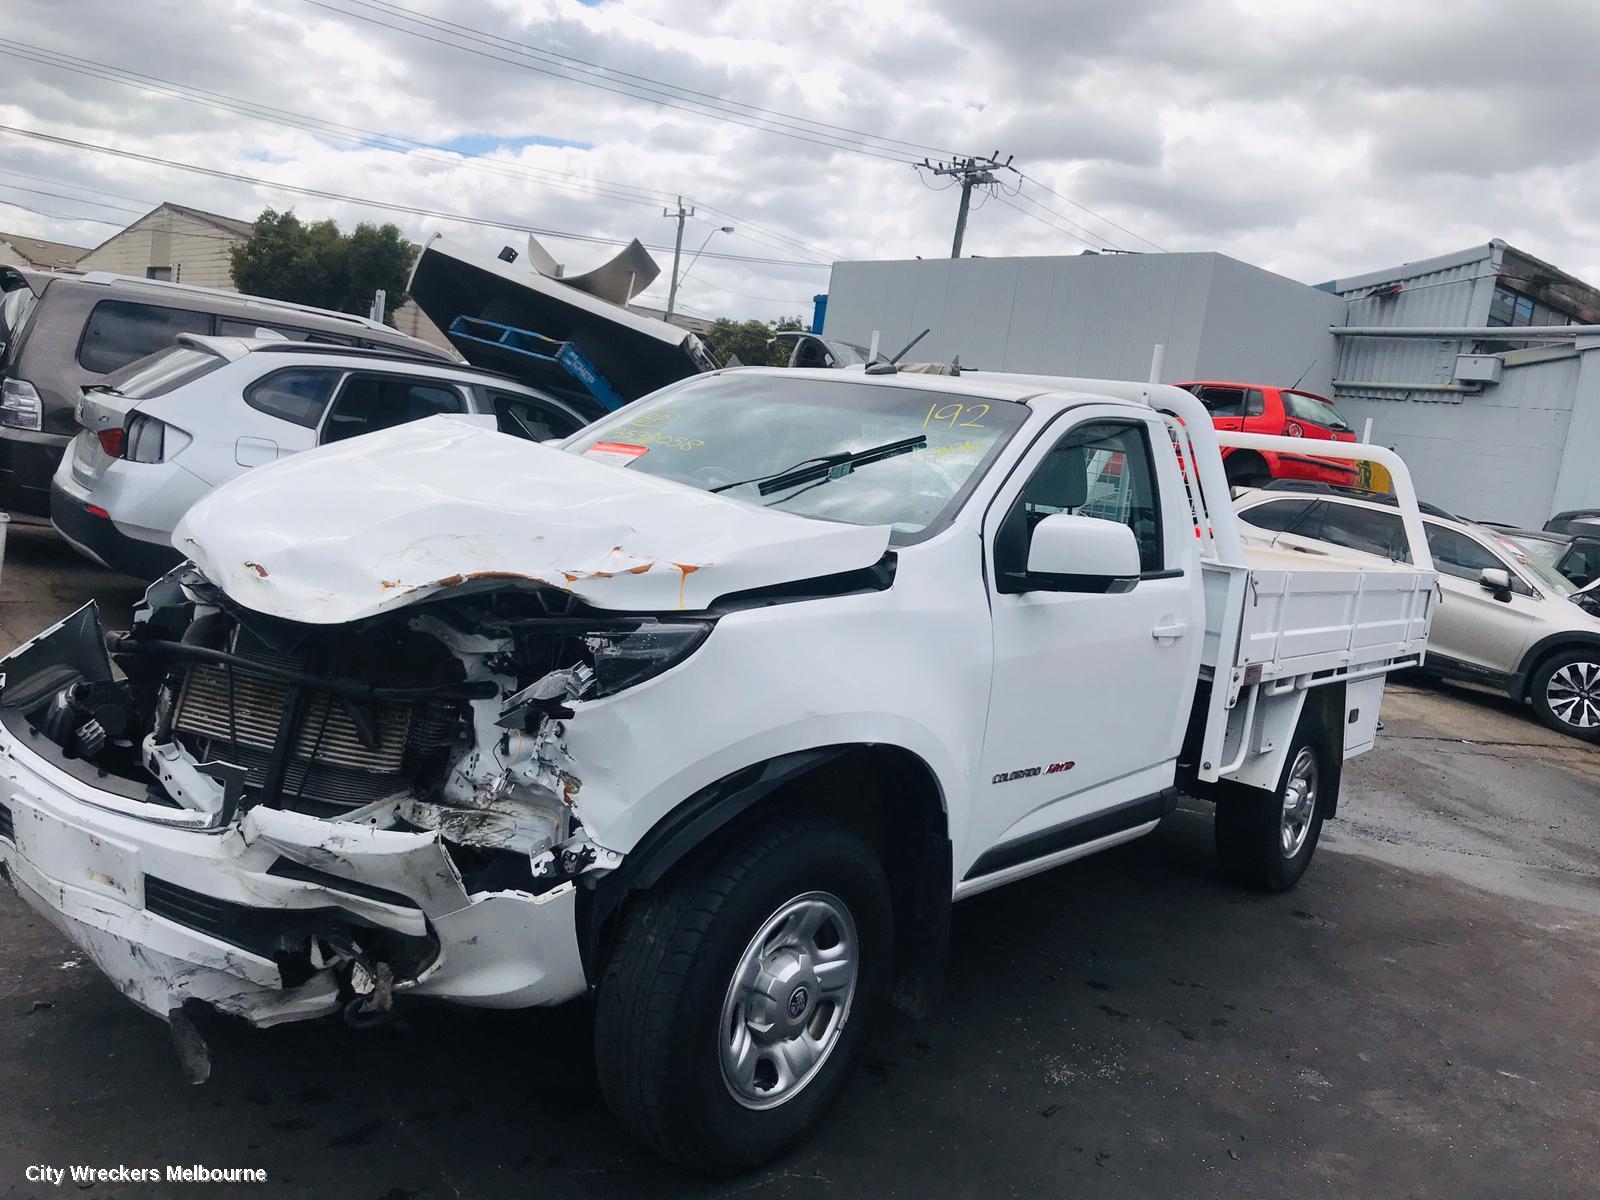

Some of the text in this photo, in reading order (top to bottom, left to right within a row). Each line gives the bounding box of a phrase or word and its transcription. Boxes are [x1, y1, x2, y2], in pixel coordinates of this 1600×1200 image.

[922, 402, 990, 429] 192
[992, 761, 1075, 784] COLORADO 4WD
